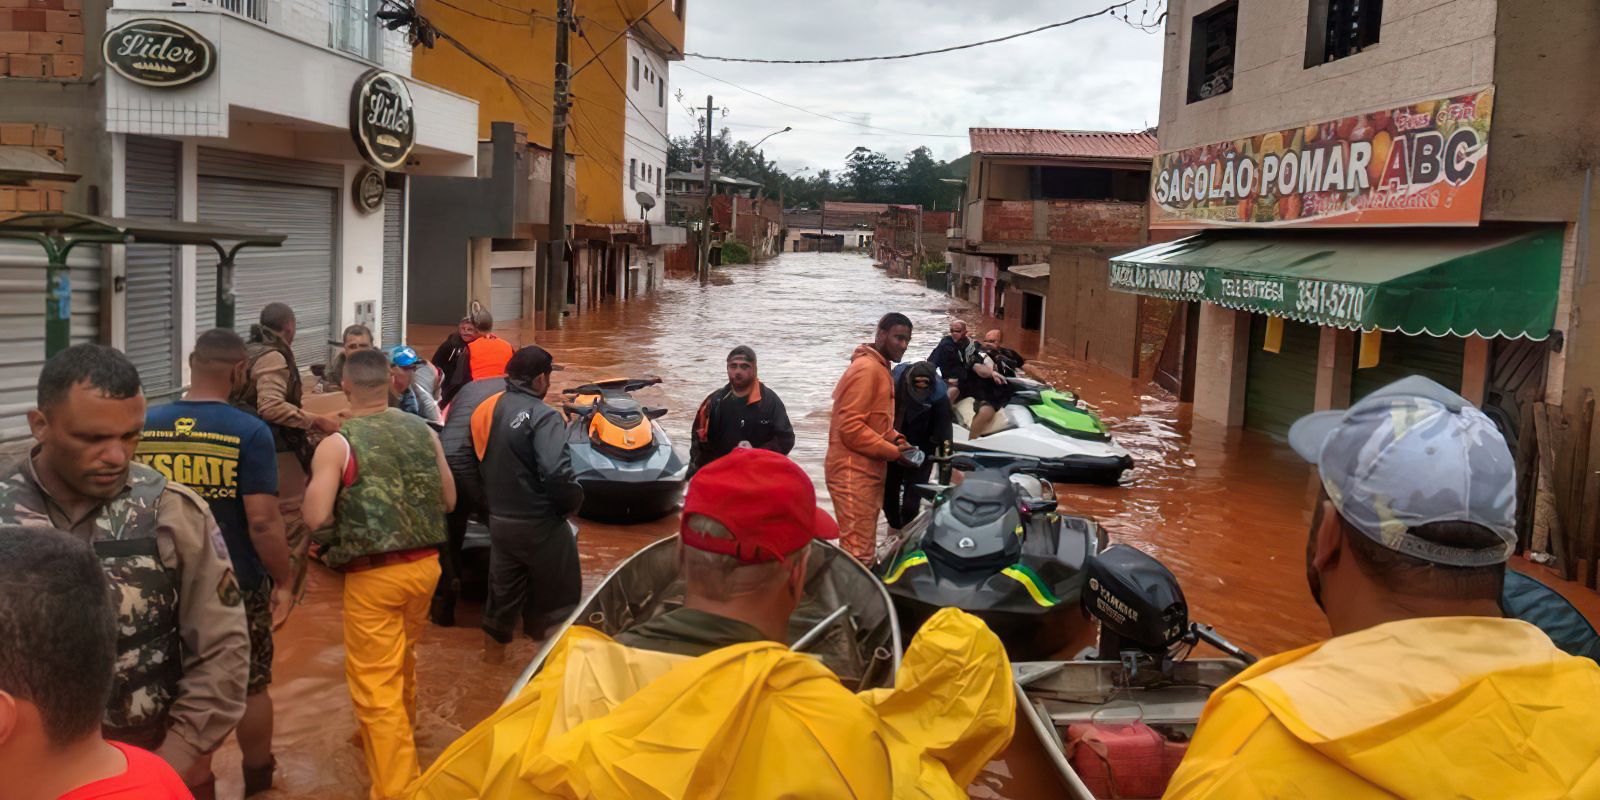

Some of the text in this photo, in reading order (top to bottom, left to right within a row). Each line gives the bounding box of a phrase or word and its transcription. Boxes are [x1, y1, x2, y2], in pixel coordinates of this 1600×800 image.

[117, 34, 197, 64] Lider
[1157, 151, 1254, 203] SACOLÃO
[1260, 141, 1372, 196] POMAR
[1377, 126, 1482, 191] ABC
[1296, 279, 1365, 322] 3541-5270
[137, 454, 238, 487] SGATE
